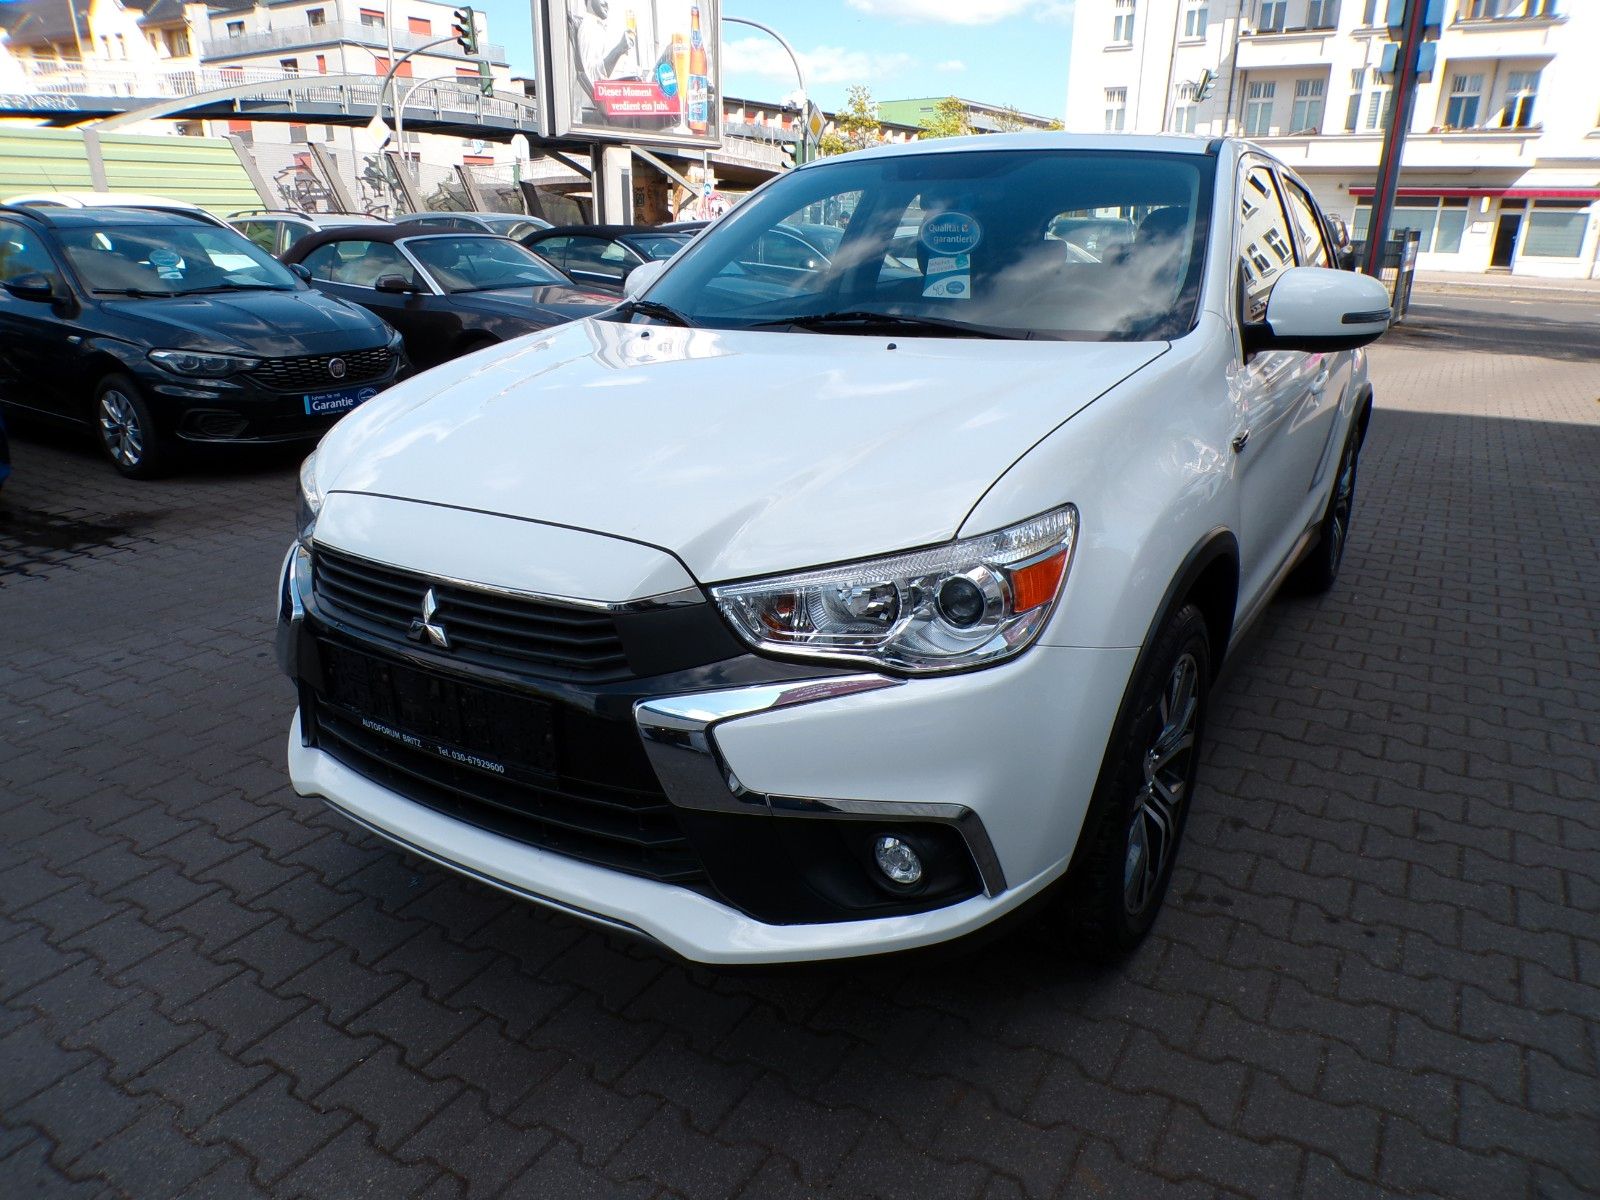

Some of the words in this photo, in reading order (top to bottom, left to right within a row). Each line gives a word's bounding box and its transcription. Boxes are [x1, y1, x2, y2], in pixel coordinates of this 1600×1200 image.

[598, 86, 621, 97] Dieser
[623, 87, 652, 97] Moment
[611, 101, 641, 111] verdient
[641, 101, 653, 111] ein
[929, 223, 959, 233] Qualität
[312, 396, 354, 411] Garantie
[362, 718, 401, 740] AUTOFORUM
[402, 734, 422, 747] BRITZ
[437, 746, 451, 757] Tel.
[451, 751, 505, 774] 030-67929600
